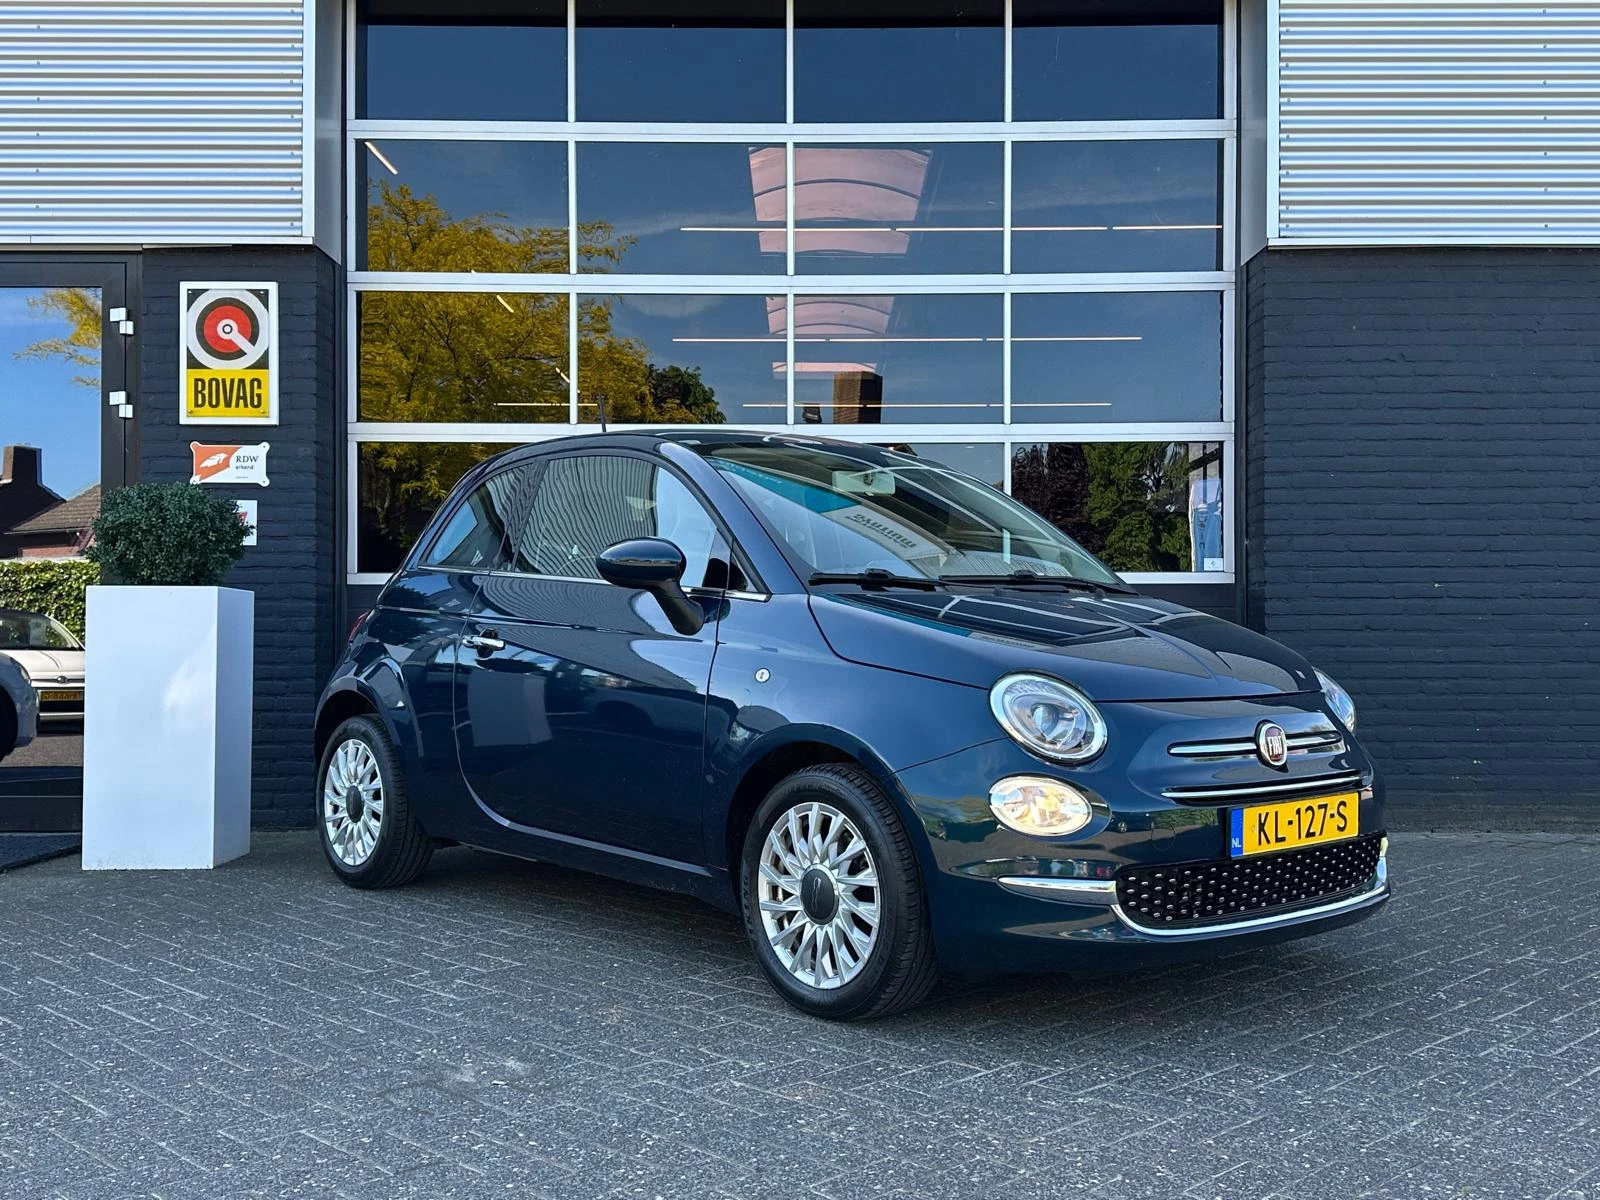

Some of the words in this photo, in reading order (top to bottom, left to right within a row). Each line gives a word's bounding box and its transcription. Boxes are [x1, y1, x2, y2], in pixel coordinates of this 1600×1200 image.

[193, 377, 262, 409] BOVAG
[235, 455, 259, 463] RDW
[1258, 800, 1347, 846] KL-127-S
[1231, 837, 1242, 849] NL
